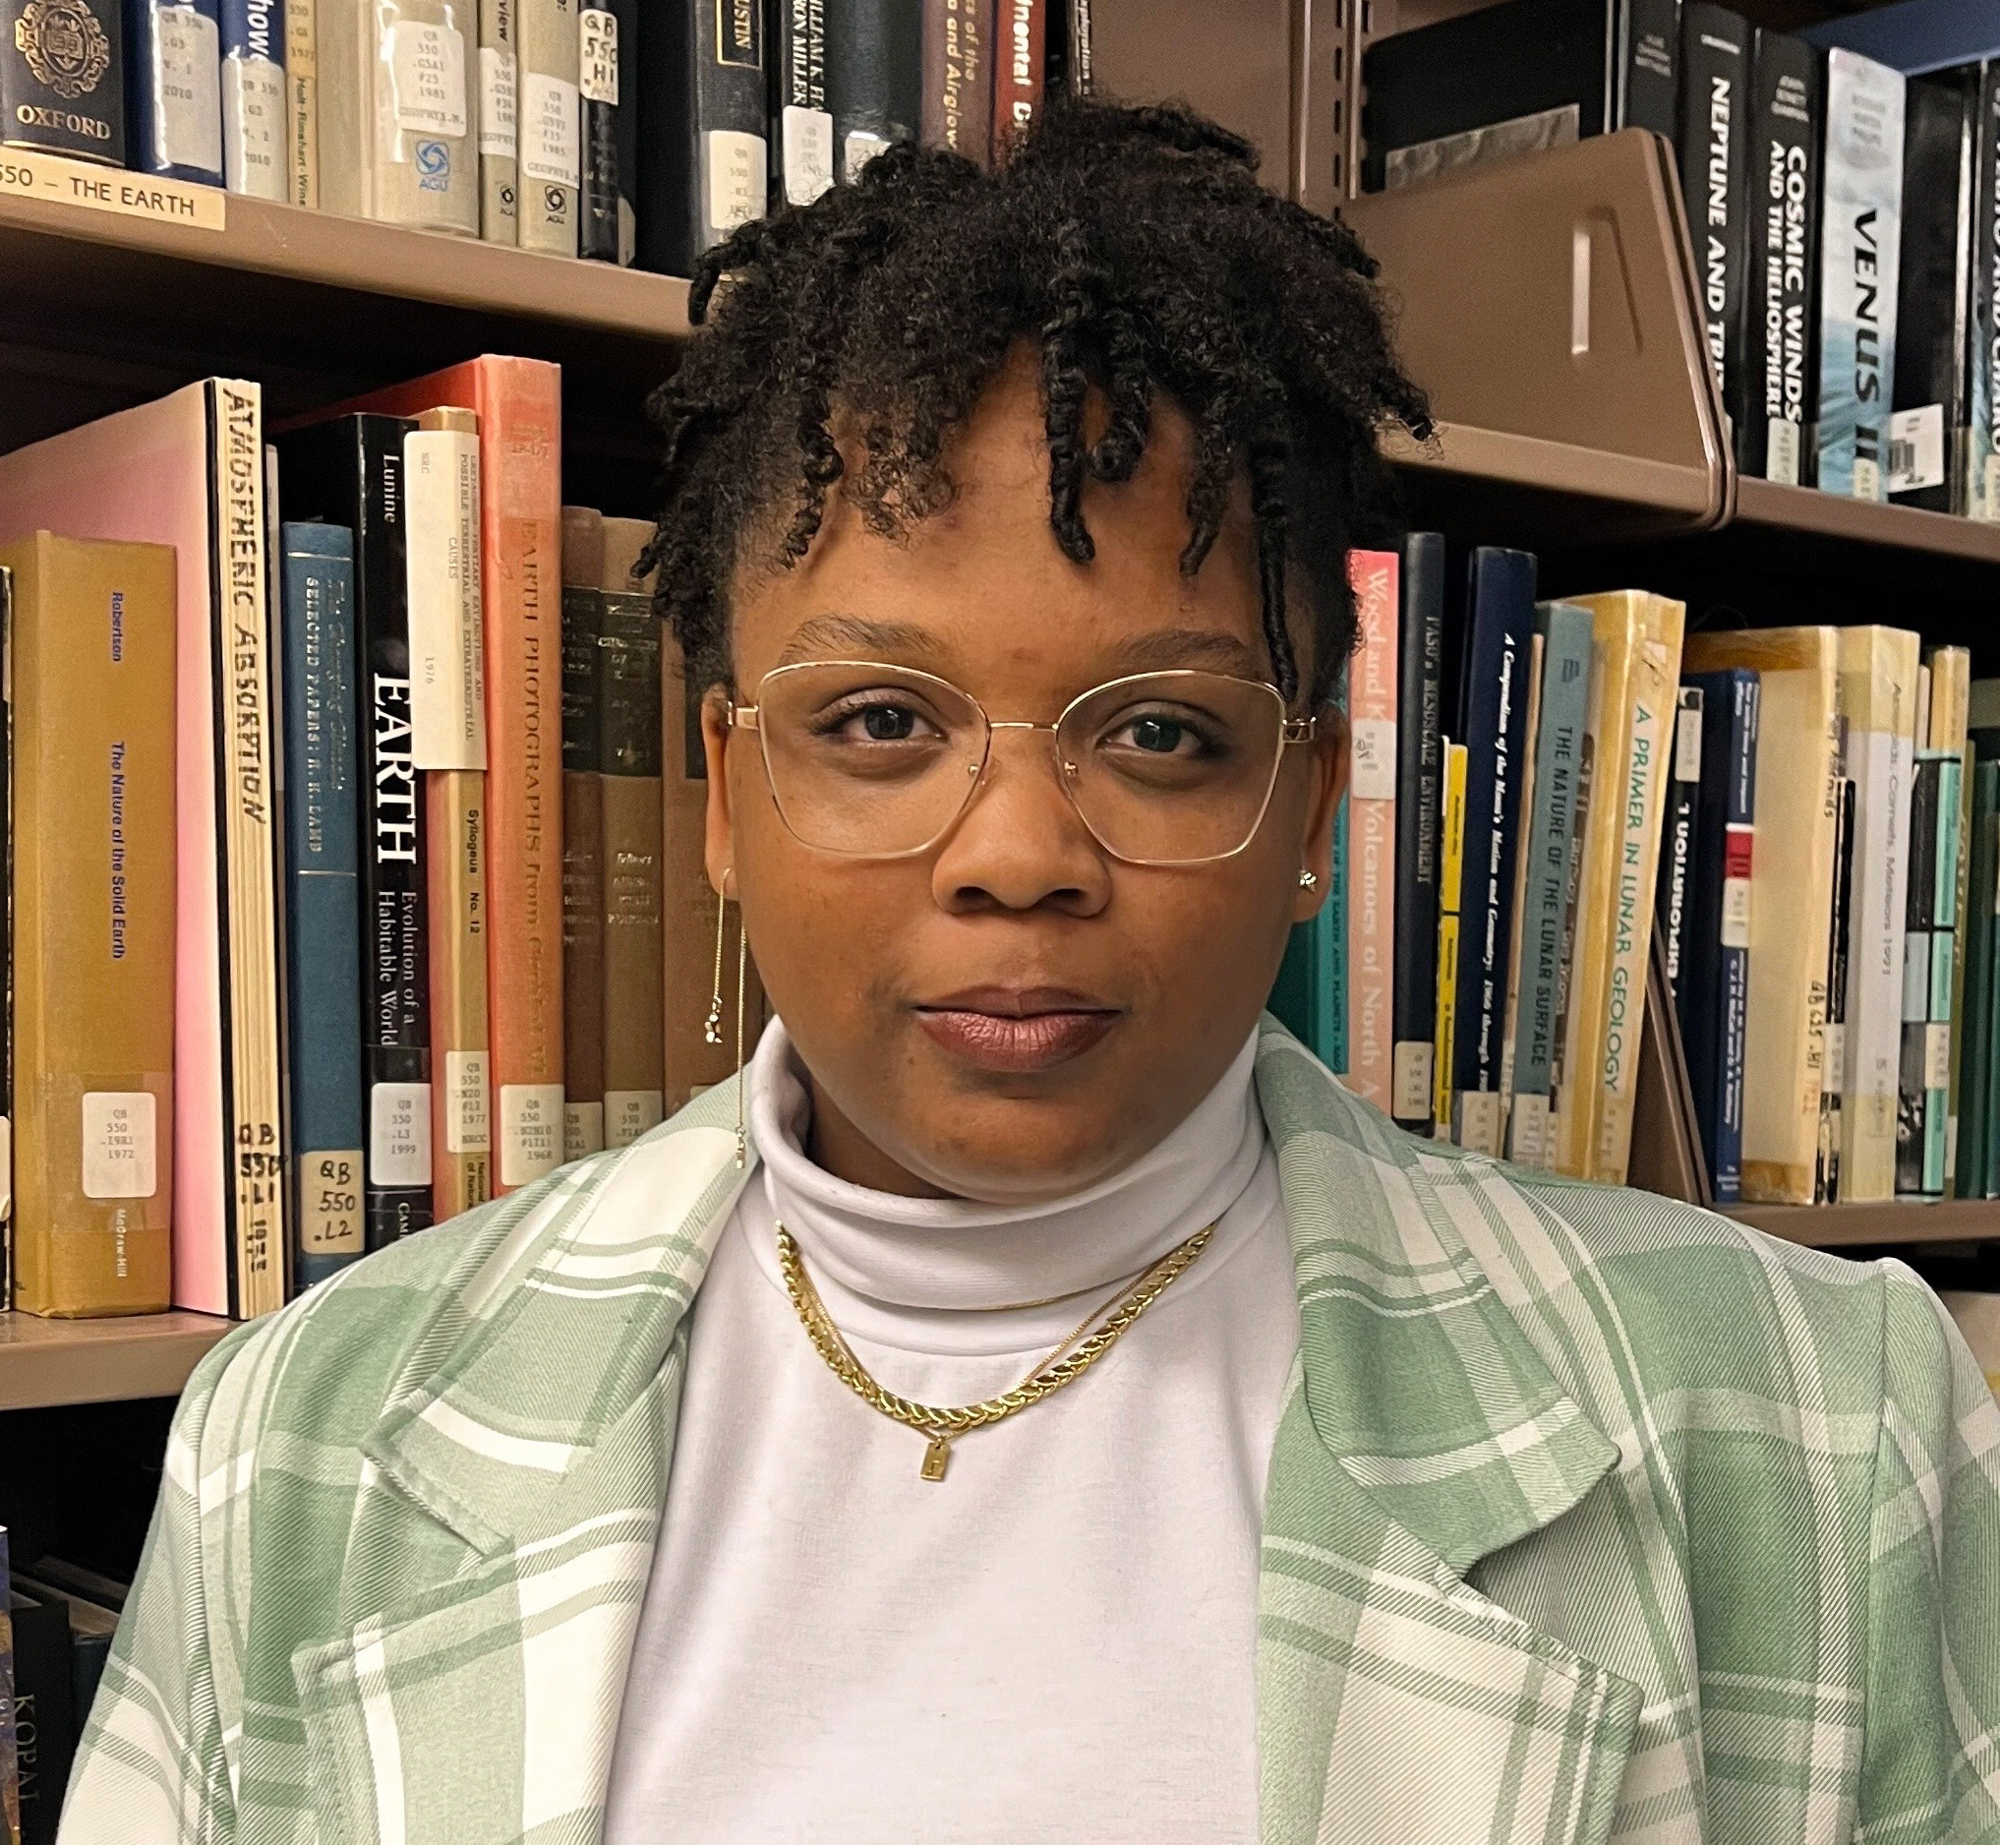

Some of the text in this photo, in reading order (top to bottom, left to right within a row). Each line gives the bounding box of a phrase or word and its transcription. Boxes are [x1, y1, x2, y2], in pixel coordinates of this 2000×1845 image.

[585, 14, 614, 38] QB
[965, 22, 980, 81] of the
[792, 35, 808, 105] MILLER
[943, 18, 964, 150] and Airglow
[16, 103, 111, 140] OXFORD
[1707, 76, 1731, 228] NEPTUNE
[69, 176, 111, 201] THE
[121, 187, 195, 217] EARTH
[1785, 145, 1807, 292] COSMIC
[1707, 235, 1727, 313] AND
[1766, 139, 1785, 417] AND THE HELIOSPHERE
[1854, 209, 1880, 404] VENUS
[1784, 305, 1805, 424] WINDS
[384, 454, 400, 524] Lunine
[222, 387, 267, 825] ATMOSPHERIC ABSORPTION
[521, 521, 540, 621] EARTH
[112, 590, 124, 663] Robertson
[306, 576, 321, 667] SELECTED
[1504, 632, 1517, 646] A
[425, 656, 435, 685] 1976
[1365, 650, 1388, 695] and
[306, 673, 321, 751] PAPERS:
[523, 636, 542, 851] PHOTOGRAPHS
[1494, 737, 1509, 754] of
[1636, 705, 1653, 724] A
[373, 672, 417, 865] EARTH
[1626, 736, 1651, 831] PRIMER
[112, 741, 126, 960] The Nature of the Solid Earth
[308, 804, 323, 853] LAMB
[1622, 840, 1641, 866] IN
[525, 862, 542, 925] from
[1362, 800, 1387, 936] Volcanoes
[1530, 726, 1574, 1068] THE NATURE OF THE LUNAR SURFACE
[469, 919, 481, 935] 12
[1616, 875, 1638, 955] LUNAR
[379, 891, 399, 1047] Habitable World
[401, 891, 421, 1025] Evolution of a
[1362, 947, 1382, 976] of
[1361, 985, 1384, 1067] North
[1604, 965, 1630, 1093] GEOLOGY
[106, 1122, 128, 1134] 550
[112, 1108, 128, 1120] QB
[238, 1122, 275, 1146] QB
[391, 1114, 412, 1125] 550
[397, 1099, 412, 1110] QB
[462, 1113, 487, 1125] 1977
[108, 1149, 135, 1160] 1972
[320, 1159, 351, 1186] QB
[313, 1219, 352, 1242] .L2
[318, 1189, 356, 1212] 550
[116, 1208, 128, 1278] McGraw-Hill
